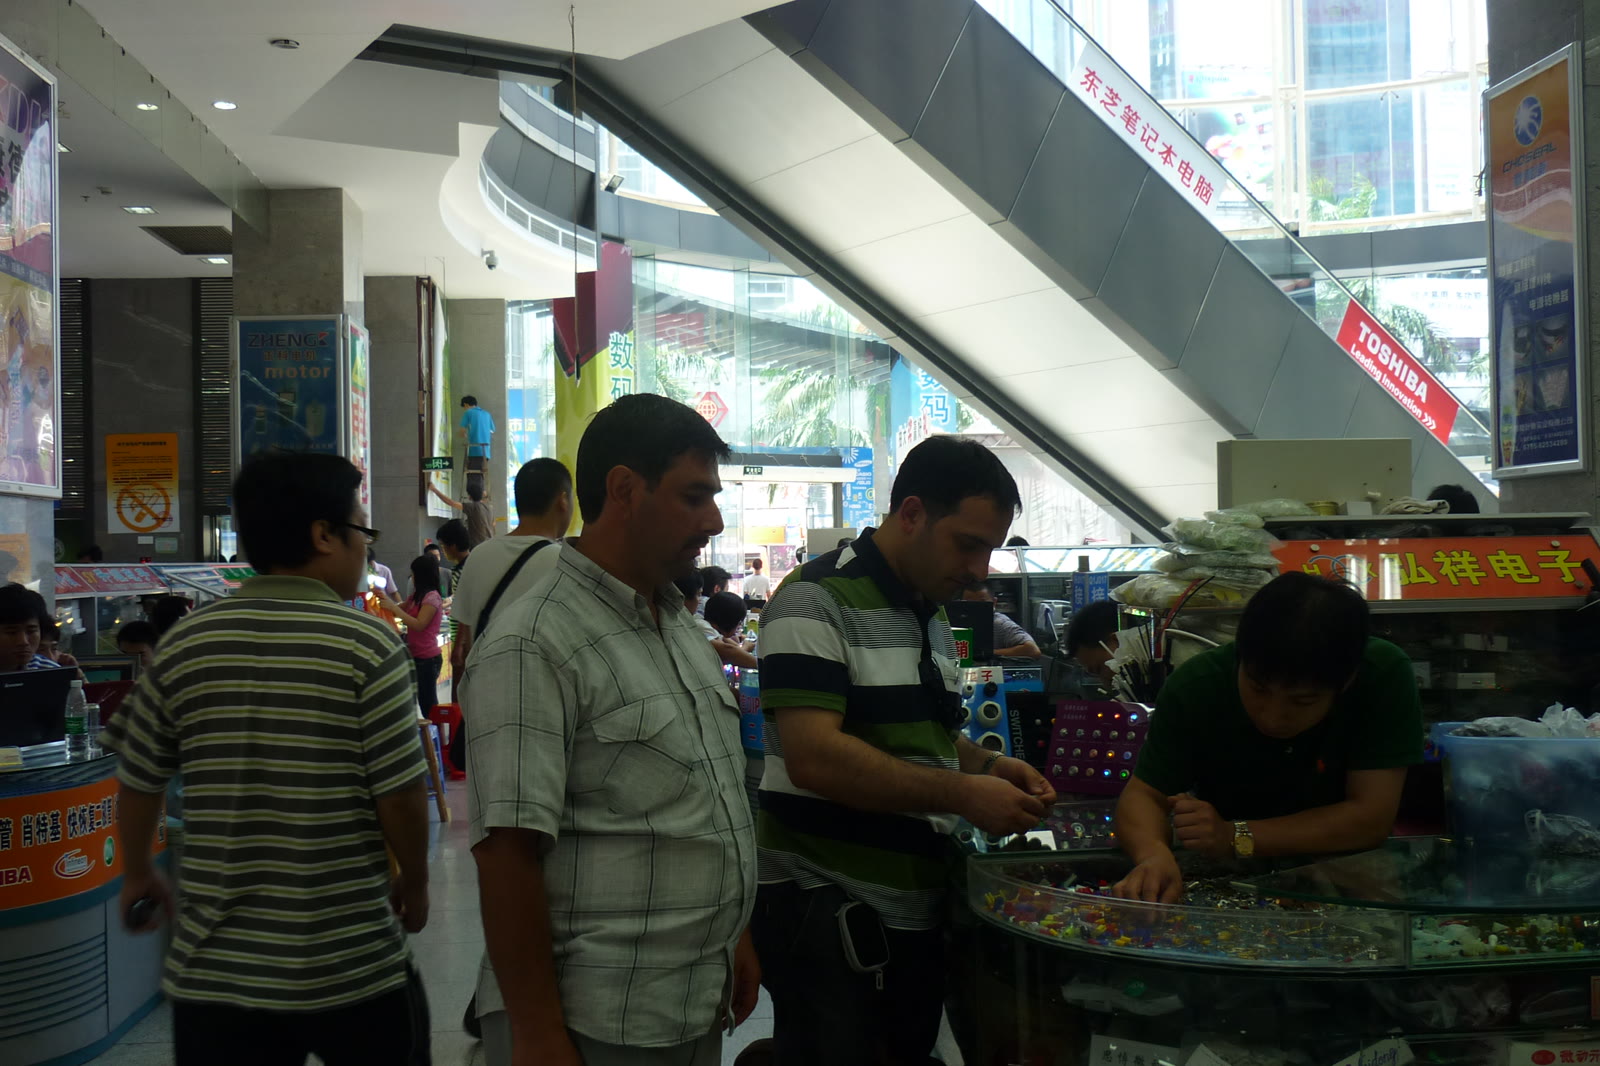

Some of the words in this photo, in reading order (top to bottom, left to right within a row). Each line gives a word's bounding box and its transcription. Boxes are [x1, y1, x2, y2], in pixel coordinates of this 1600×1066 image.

[1080, 66, 1214, 206] 东芝笔记本电脑
[264, 365, 331, 379] motor
[1350, 343, 1382, 382] Leading
[1381, 373, 1422, 419] Innovation
[1358, 321, 1428, 403] TOSHIBA
[1381, 549, 1582, 587] 弘祥电子
[22, 811, 61, 847] 肖特基
